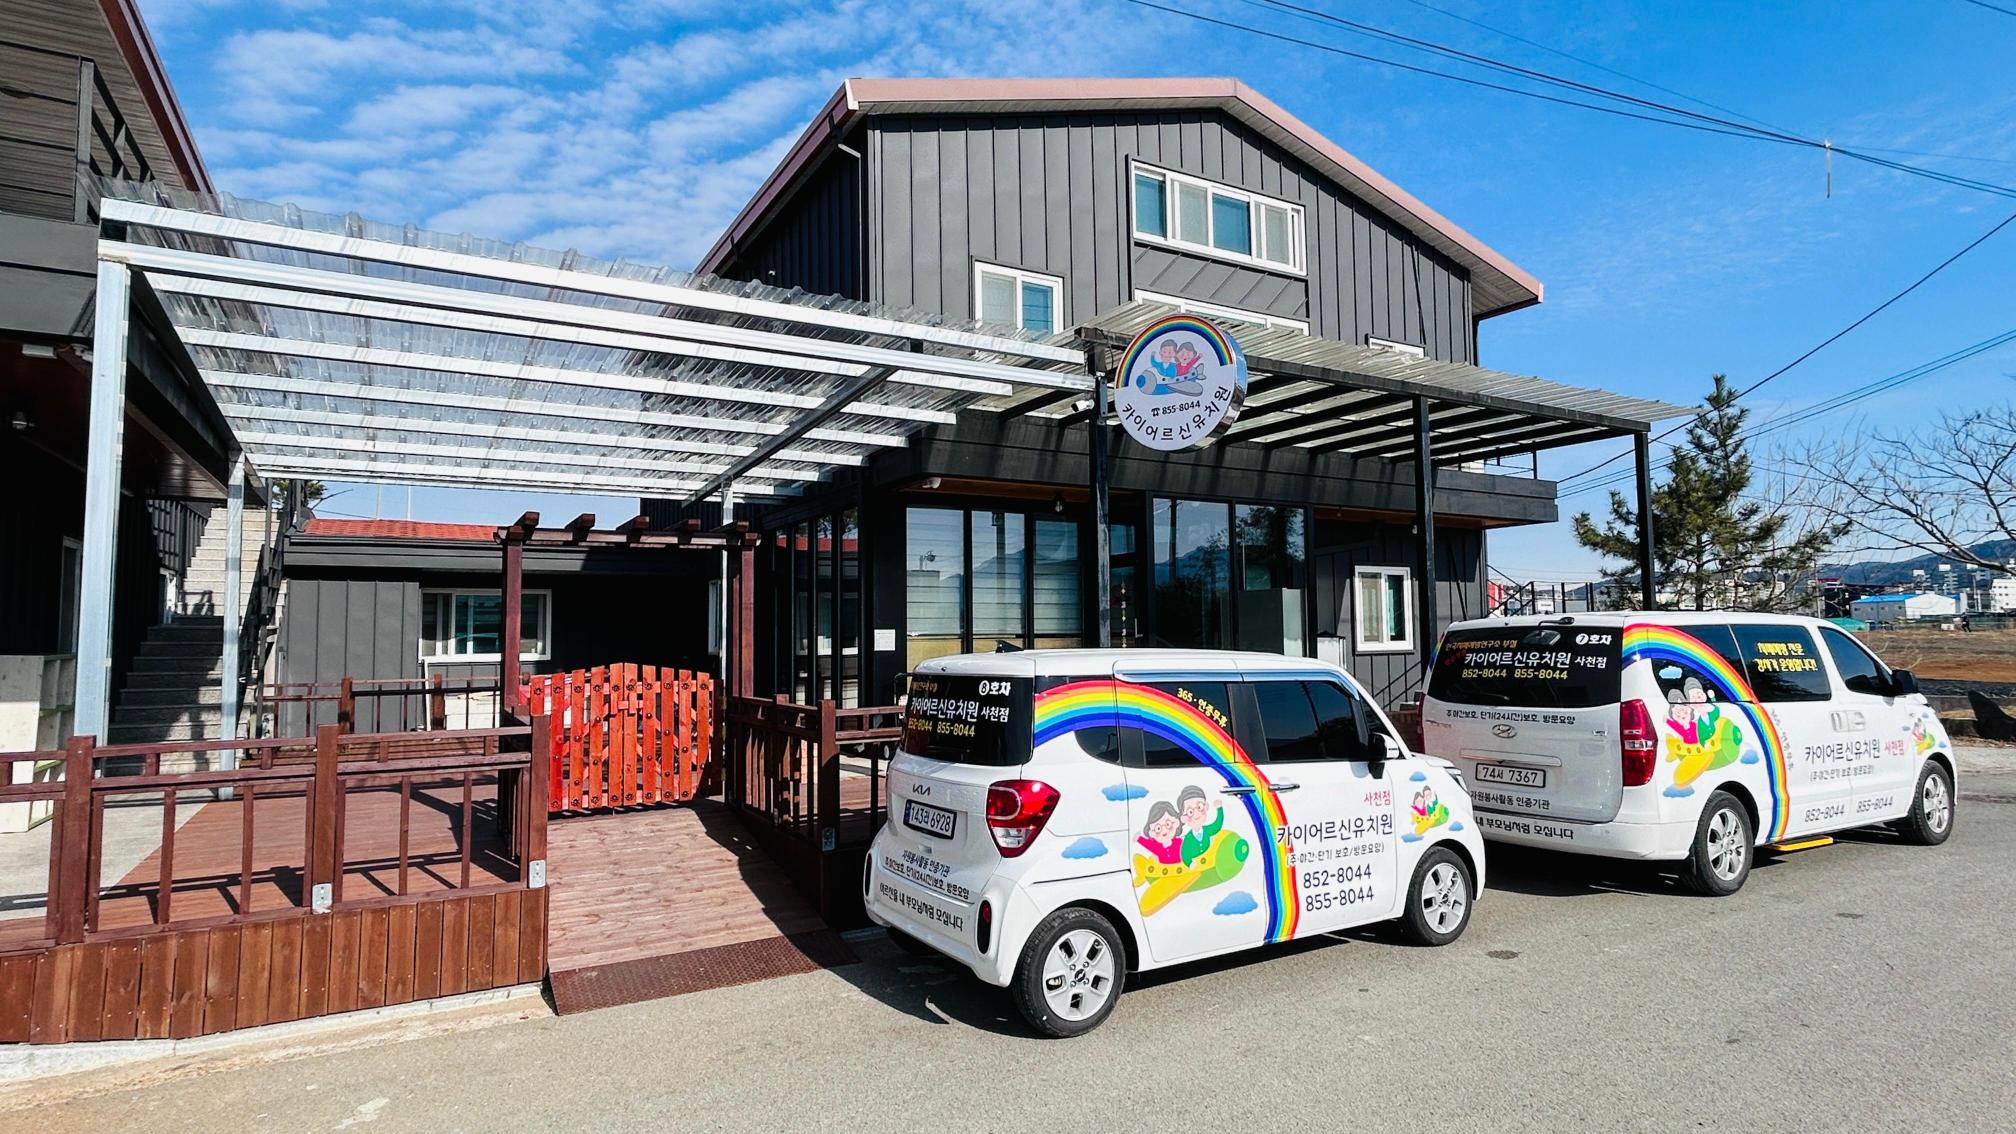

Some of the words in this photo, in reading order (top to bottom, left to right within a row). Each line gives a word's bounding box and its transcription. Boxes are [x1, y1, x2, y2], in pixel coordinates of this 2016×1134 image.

[1122, 386, 1232, 440] 카이어르신유치원
[1162, 400, 1201, 415] 855-8044
[1464, 651, 1571, 668] 카이어르신유치원
[1574, 655, 1607, 669] 사천점
[1462, 668, 1507, 678] 852-8044
[1514, 668, 1568, 680] 855-8044
[910, 697, 979, 722] 카이어르신유치원
[980, 706, 1010, 723] 사천점
[937, 722, 976, 737] 855-8044
[1804, 738, 1881, 764] 카이어르신유치원
[1508, 769, 1538, 783] 7367
[1364, 790, 1391, 807] 사천점
[1470, 790, 1514, 806] 자원봉사활동
[1515, 797, 1550, 810] 인증기관
[1804, 805, 1845, 823] 852-8044
[1856, 796, 1894, 813] 855-8044
[930, 811, 951, 833] 6928
[1276, 813, 1393, 846] 카이어르신유치원
[1486, 817, 1530, 834] 부모님처럼
[1533, 825, 1575, 840] 모십니다
[1303, 863, 1372, 889] 852-8044
[1305, 886, 1375, 912] 855-8044
[936, 908, 963, 932] 모십니다
